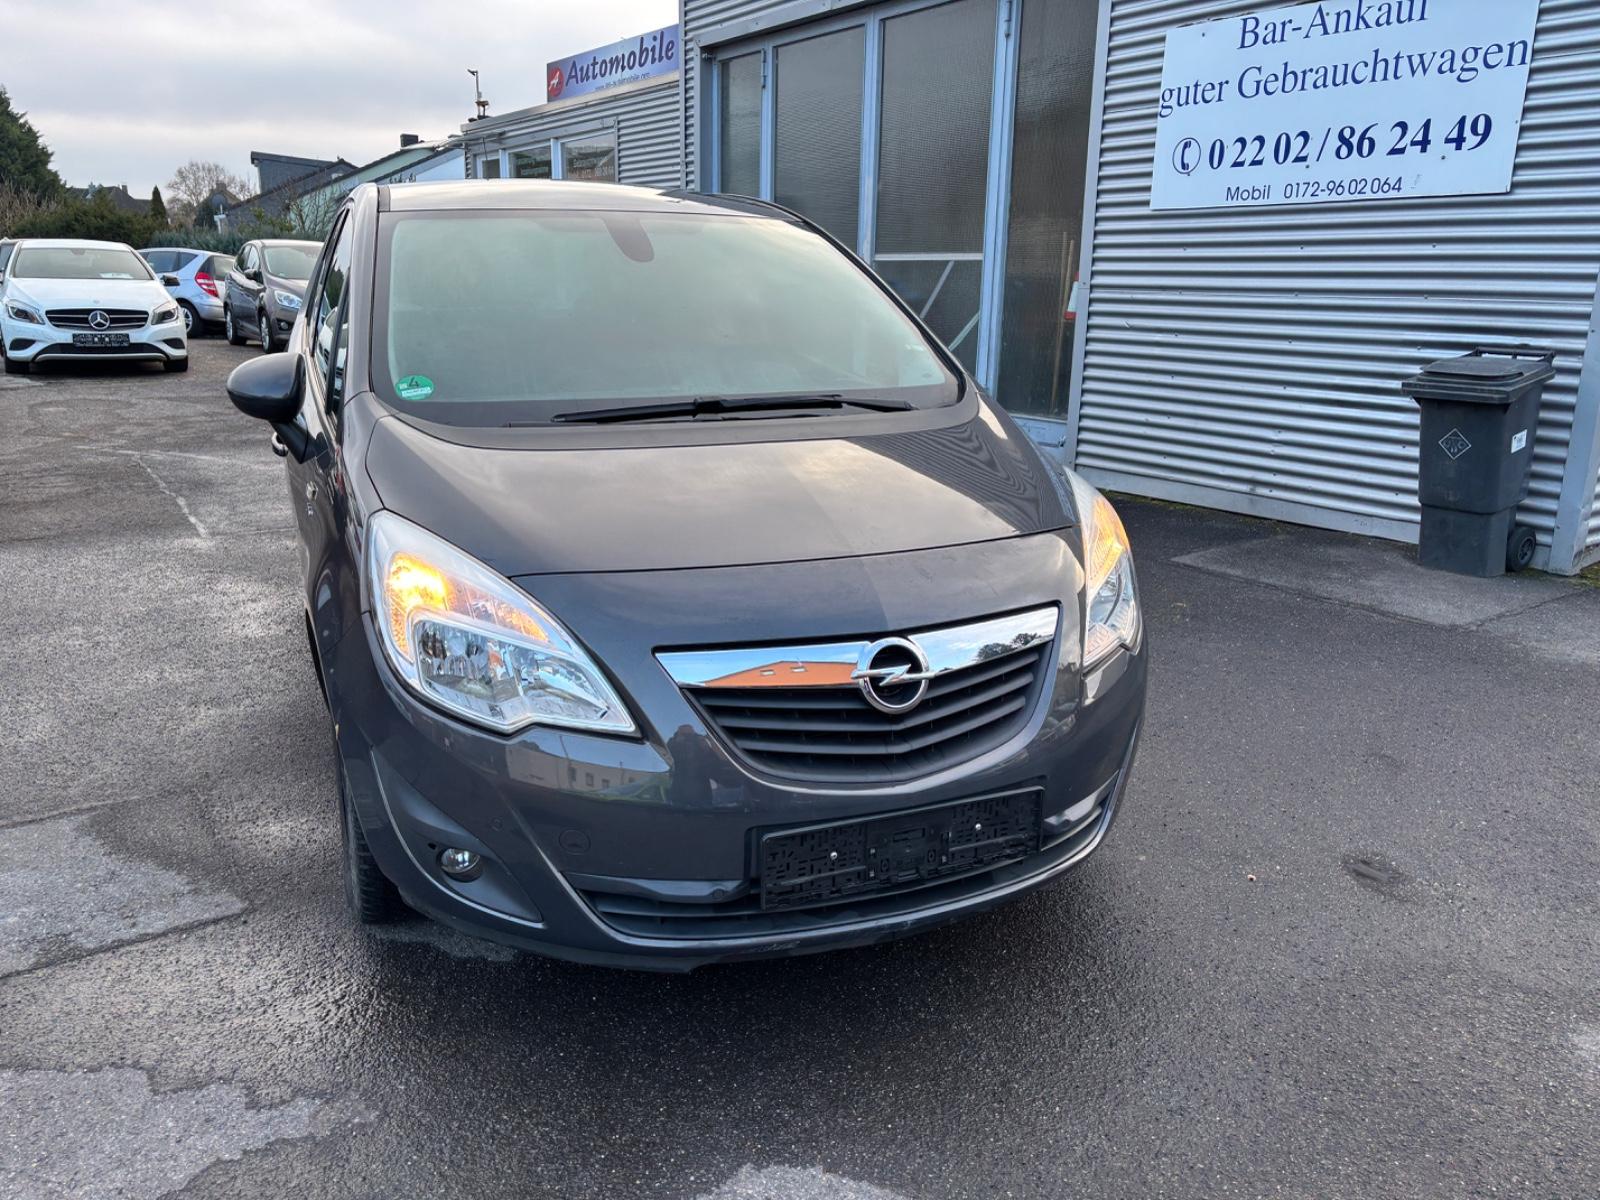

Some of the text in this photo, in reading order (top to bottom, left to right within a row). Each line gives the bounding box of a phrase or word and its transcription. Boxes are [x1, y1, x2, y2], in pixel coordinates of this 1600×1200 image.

[565, 31, 675, 86] Automobile
[1159, 39, 1528, 117] guter Gebrauchtwagen
[1225, 184, 1271, 201] Mobil
